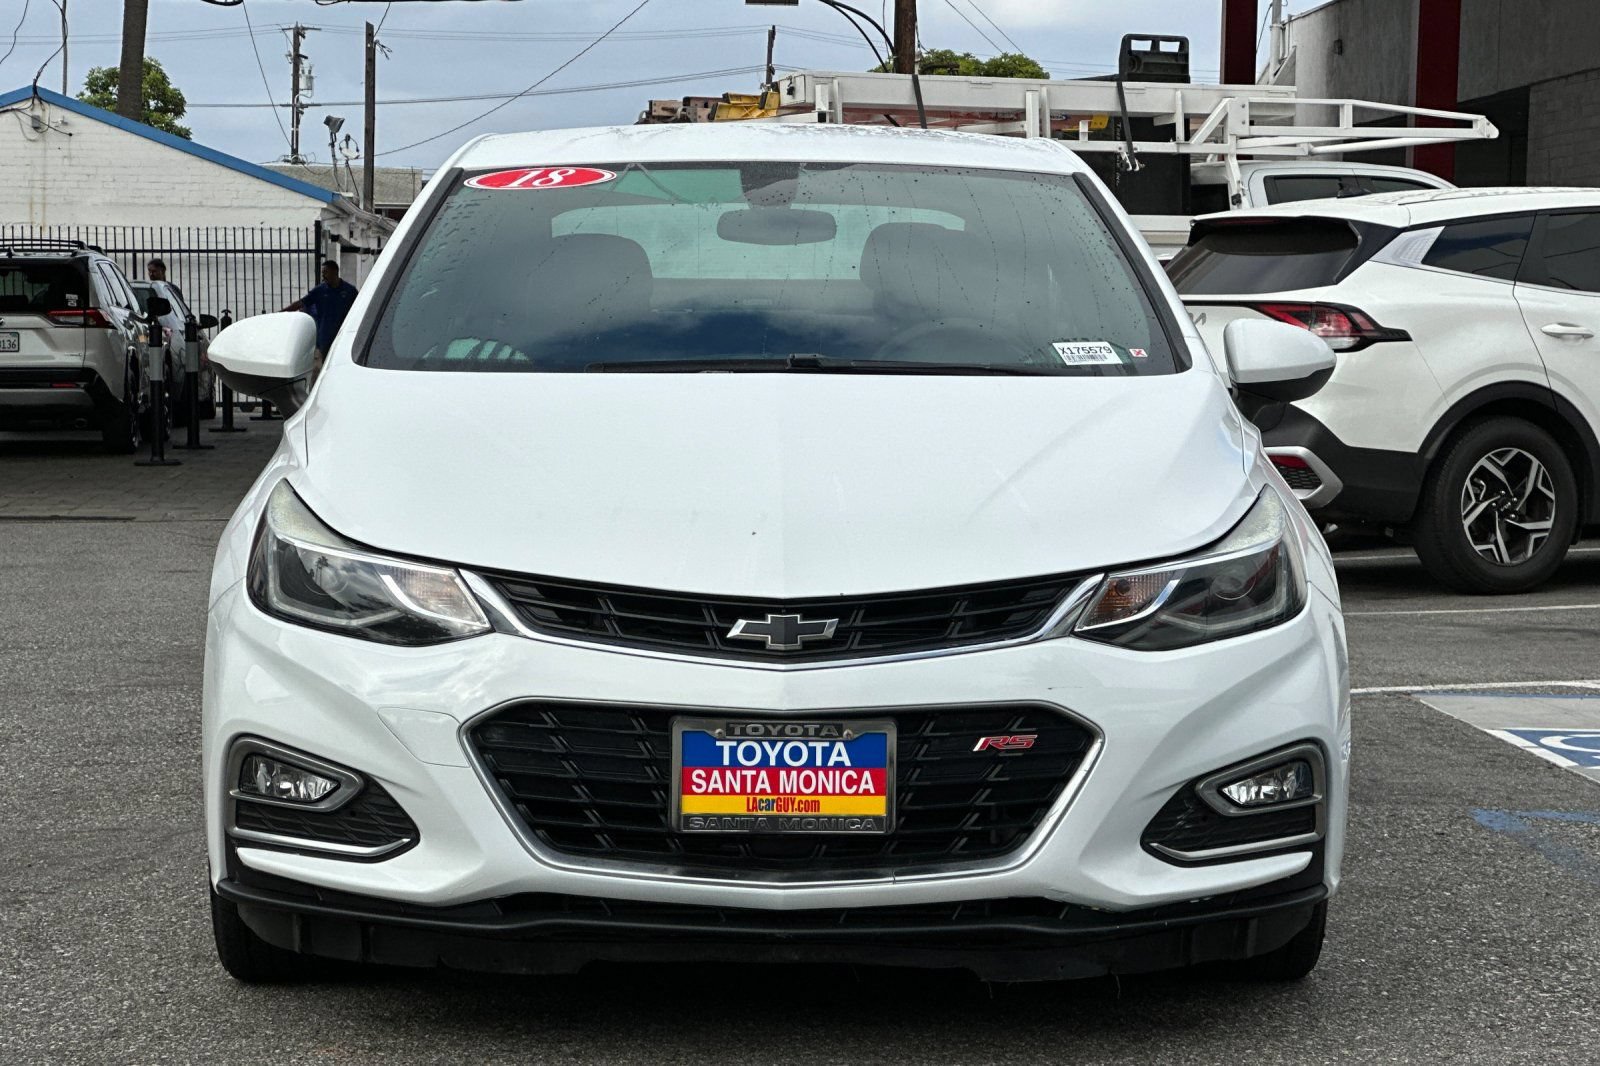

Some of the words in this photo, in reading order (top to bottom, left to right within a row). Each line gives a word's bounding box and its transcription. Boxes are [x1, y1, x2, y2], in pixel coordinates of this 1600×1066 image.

[500, 169, 575, 187] 18
[1058, 345, 1113, 355] X175579
[729, 723, 839, 736] TOYOTA
[973, 734, 1038, 752] RS
[716, 741, 852, 767] TOYOTA
[691, 769, 772, 794] SANTA
[779, 770, 875, 794] MONICA
[746, 797, 821, 813] LAcarGUY.com
[689, 817, 772, 830] SANTA
[778, 818, 878, 830] MONICA
